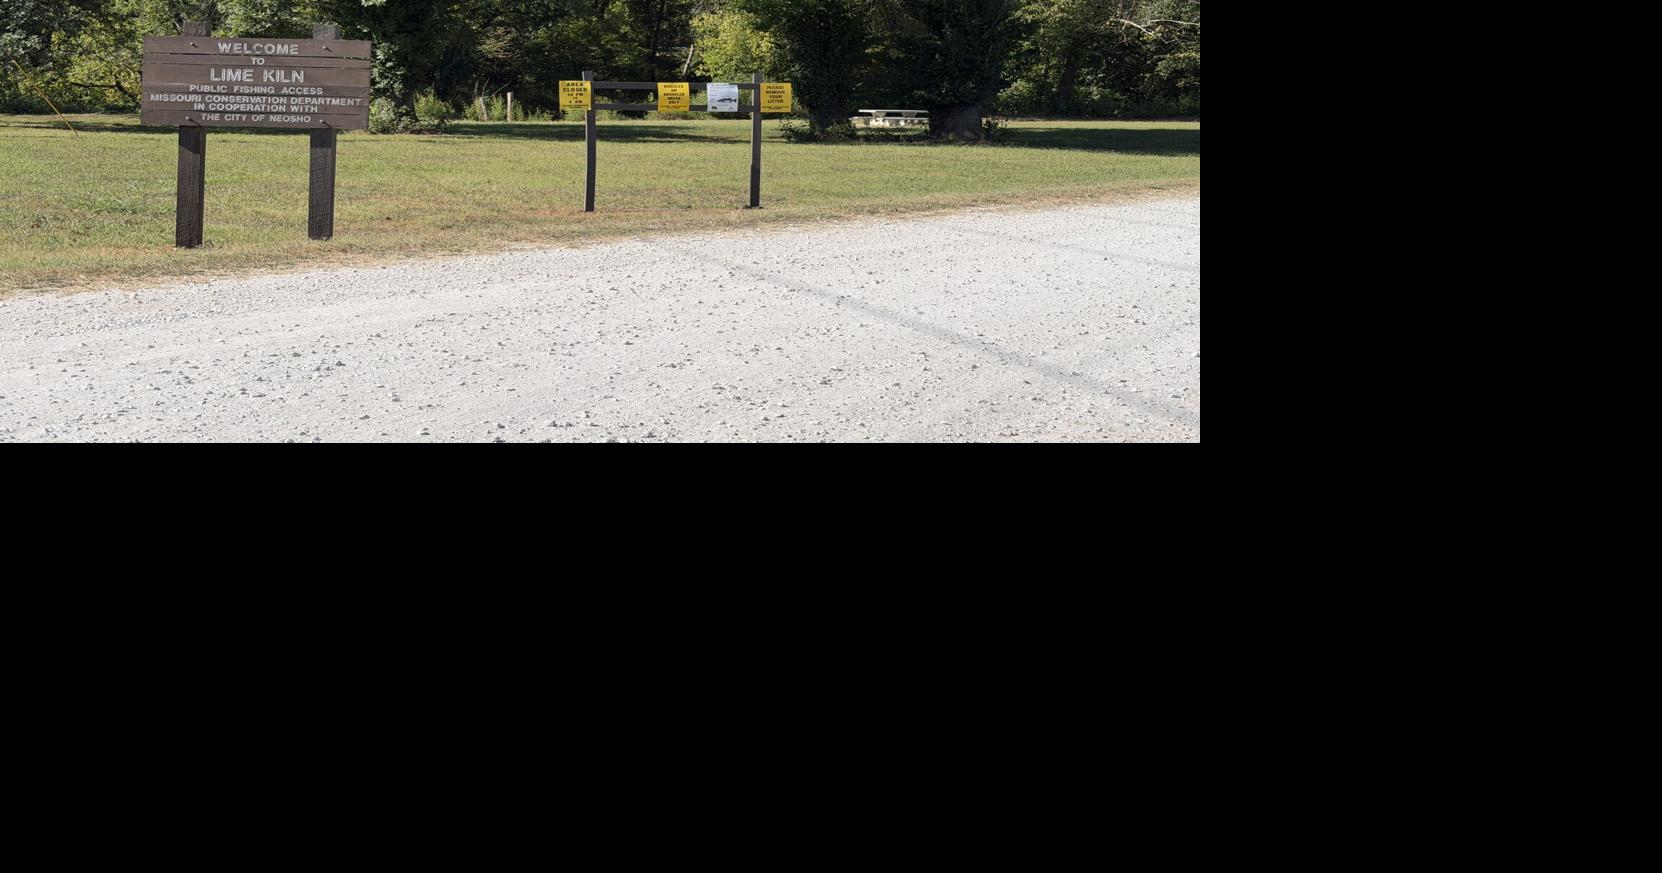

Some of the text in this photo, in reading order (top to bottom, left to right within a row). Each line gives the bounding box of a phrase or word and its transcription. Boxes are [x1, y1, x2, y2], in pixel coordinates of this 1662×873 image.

[217, 42, 299, 55] WELCOME
[250, 57, 265, 66] TO
[210, 68, 304, 83] LIME KILN
[189, 84, 324, 95] PUBLIC FISHING ACCESS
[150, 93, 361, 106] MISSOURI CONSERVATION DEPARTMENT
[193, 102, 318, 113] IN COOPERATION WITH
[201, 113, 311, 123] THE CITY OF NEOSHO
